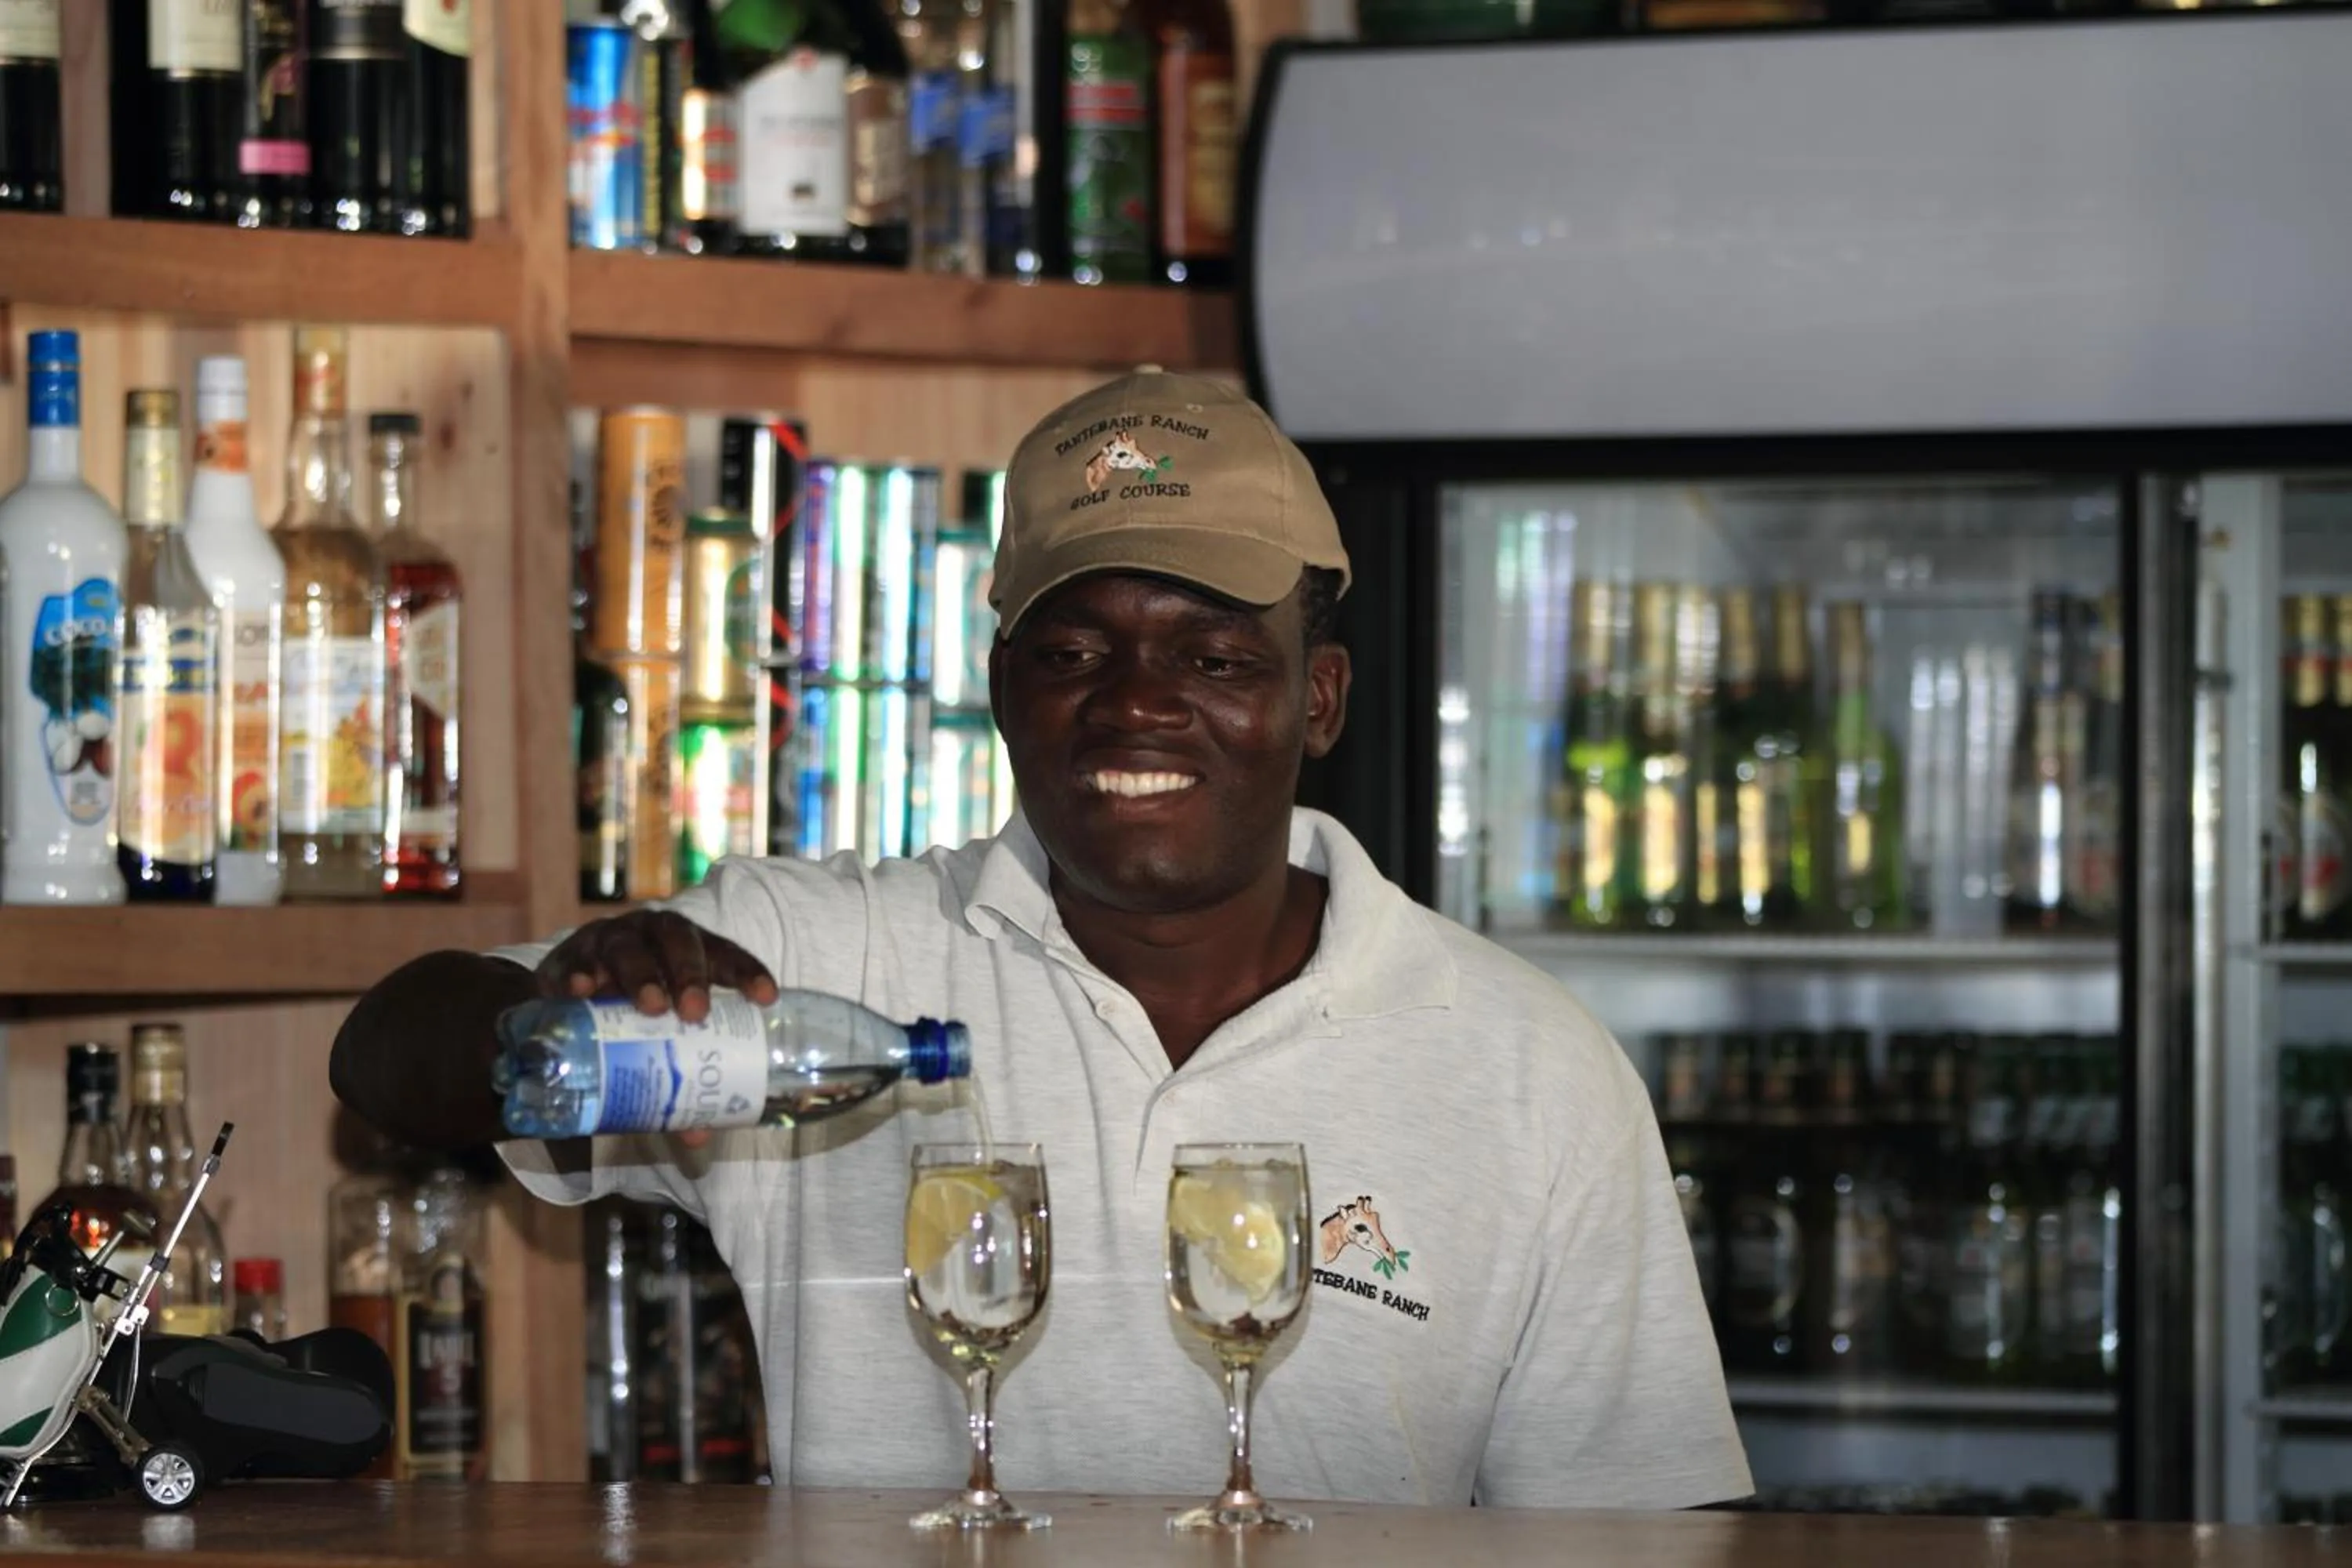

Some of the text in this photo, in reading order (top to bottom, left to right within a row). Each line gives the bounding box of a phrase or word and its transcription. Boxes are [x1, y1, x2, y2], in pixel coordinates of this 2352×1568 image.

[1054, 415, 1210, 457] TANTEBANE RANCH
[1070, 483, 1191, 510] GOLF COURSE
[1382, 1290, 1431, 1321] RANCH
